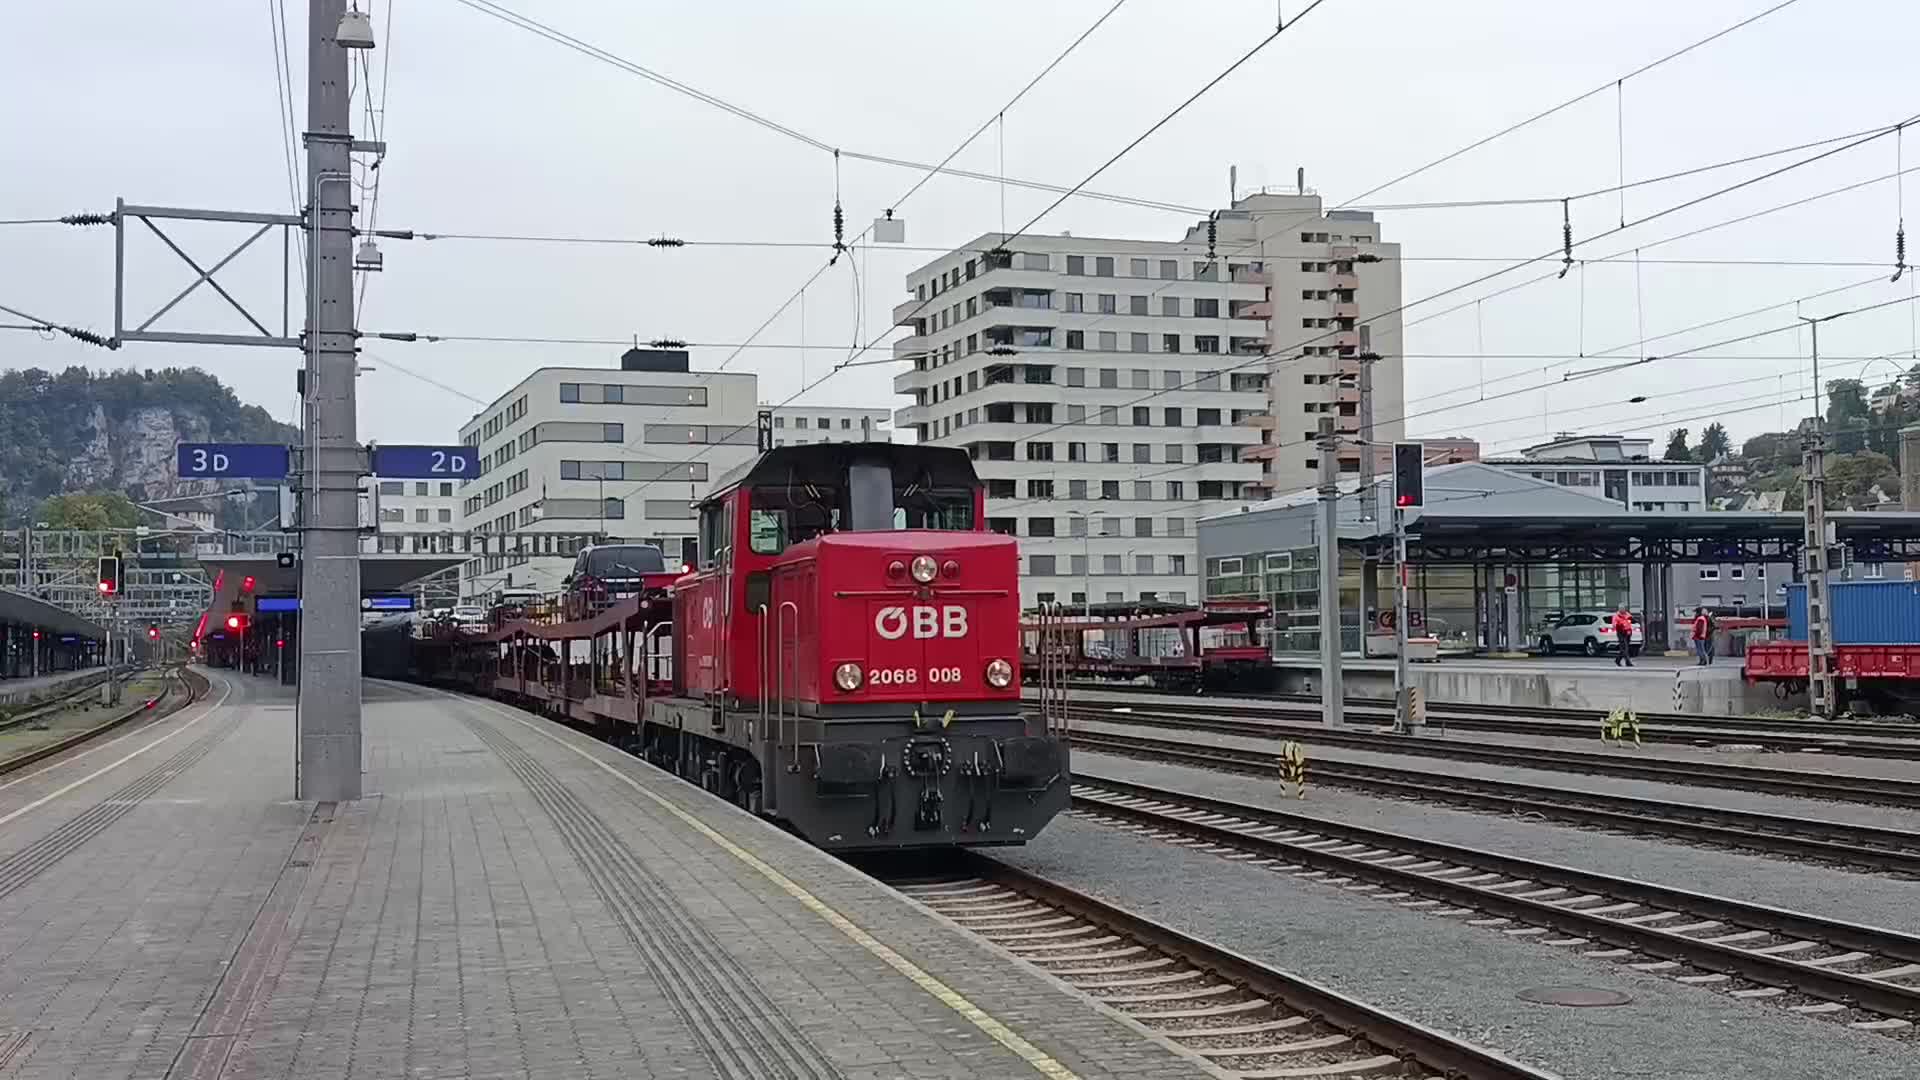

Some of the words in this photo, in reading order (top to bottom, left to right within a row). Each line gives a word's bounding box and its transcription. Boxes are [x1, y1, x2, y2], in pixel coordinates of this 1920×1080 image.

[875, 605, 968, 640] ÖBB
[869, 668, 918, 685] 2068
[928, 666, 962, 683] 008
